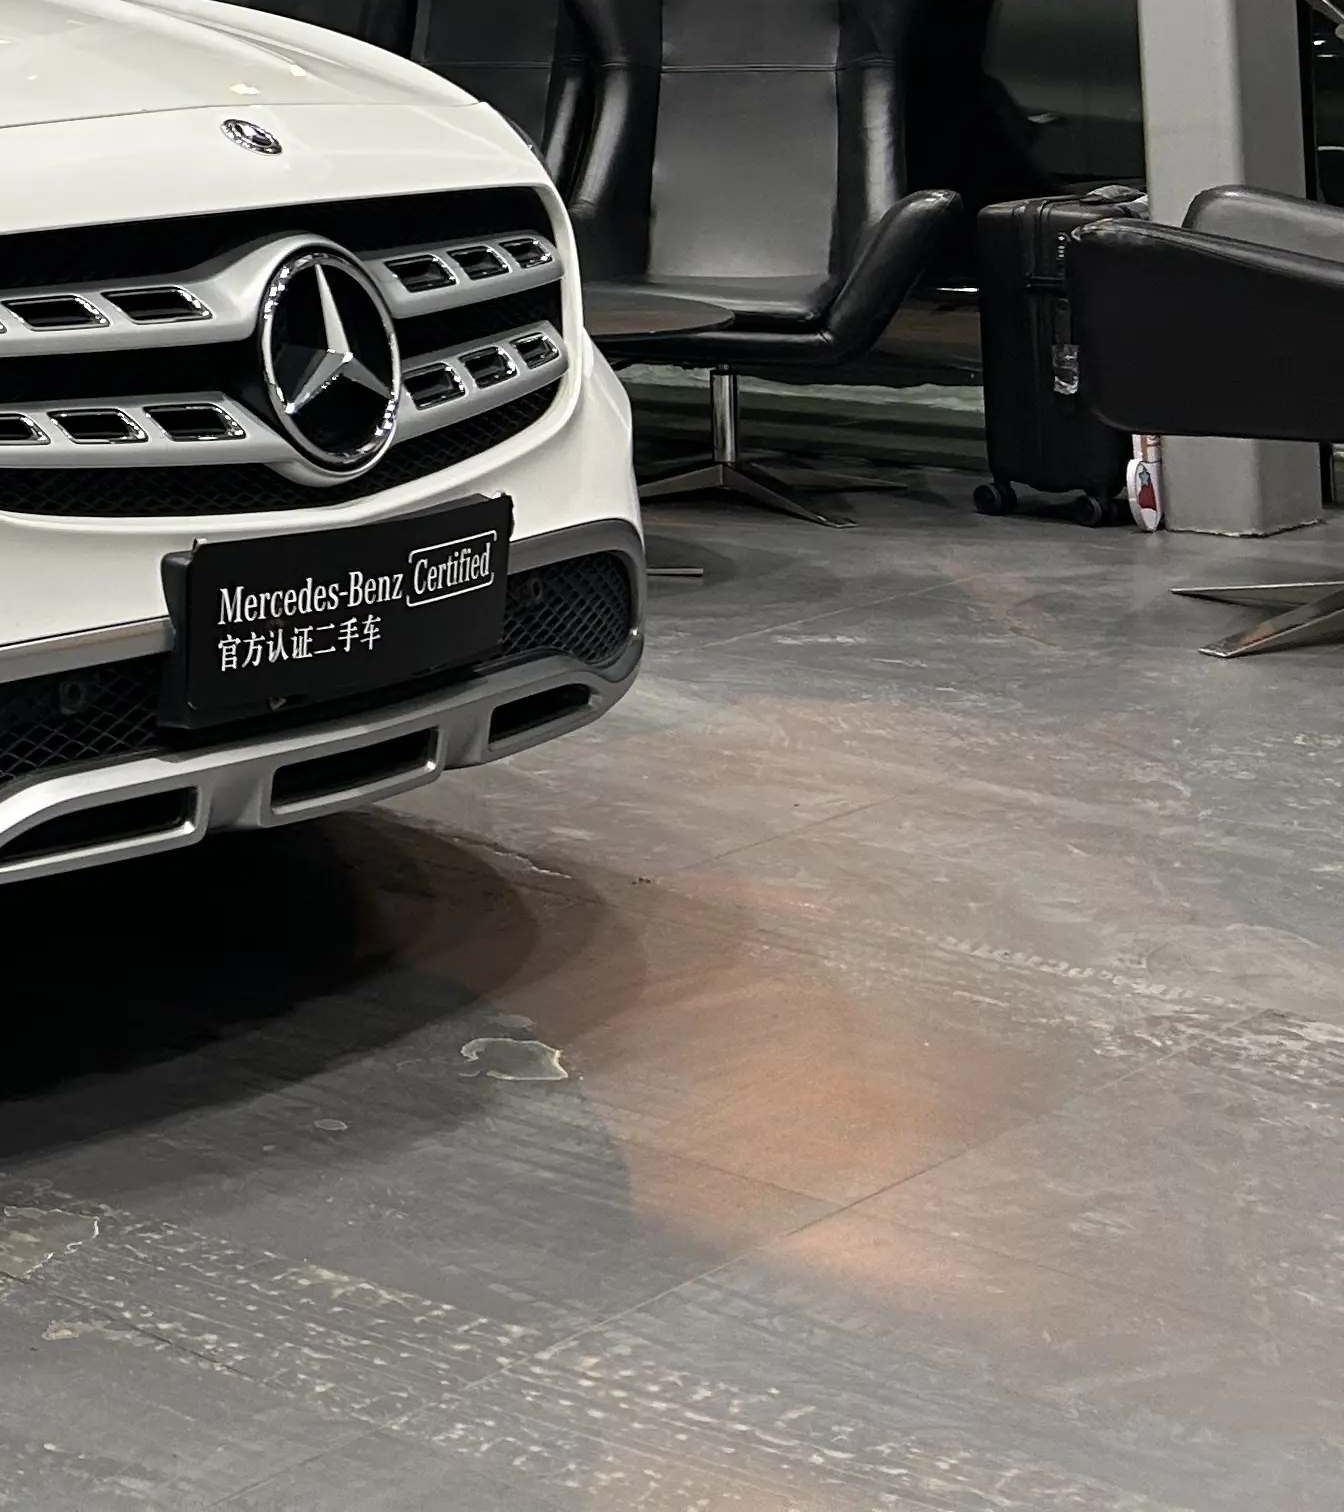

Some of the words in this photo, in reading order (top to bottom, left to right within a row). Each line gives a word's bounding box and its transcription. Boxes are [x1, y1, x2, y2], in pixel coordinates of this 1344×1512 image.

[217, 571, 404, 626] Mercedes-Benz
[413, 542, 492, 596] Certified
[217, 614, 382, 672] 官方认证二手车
